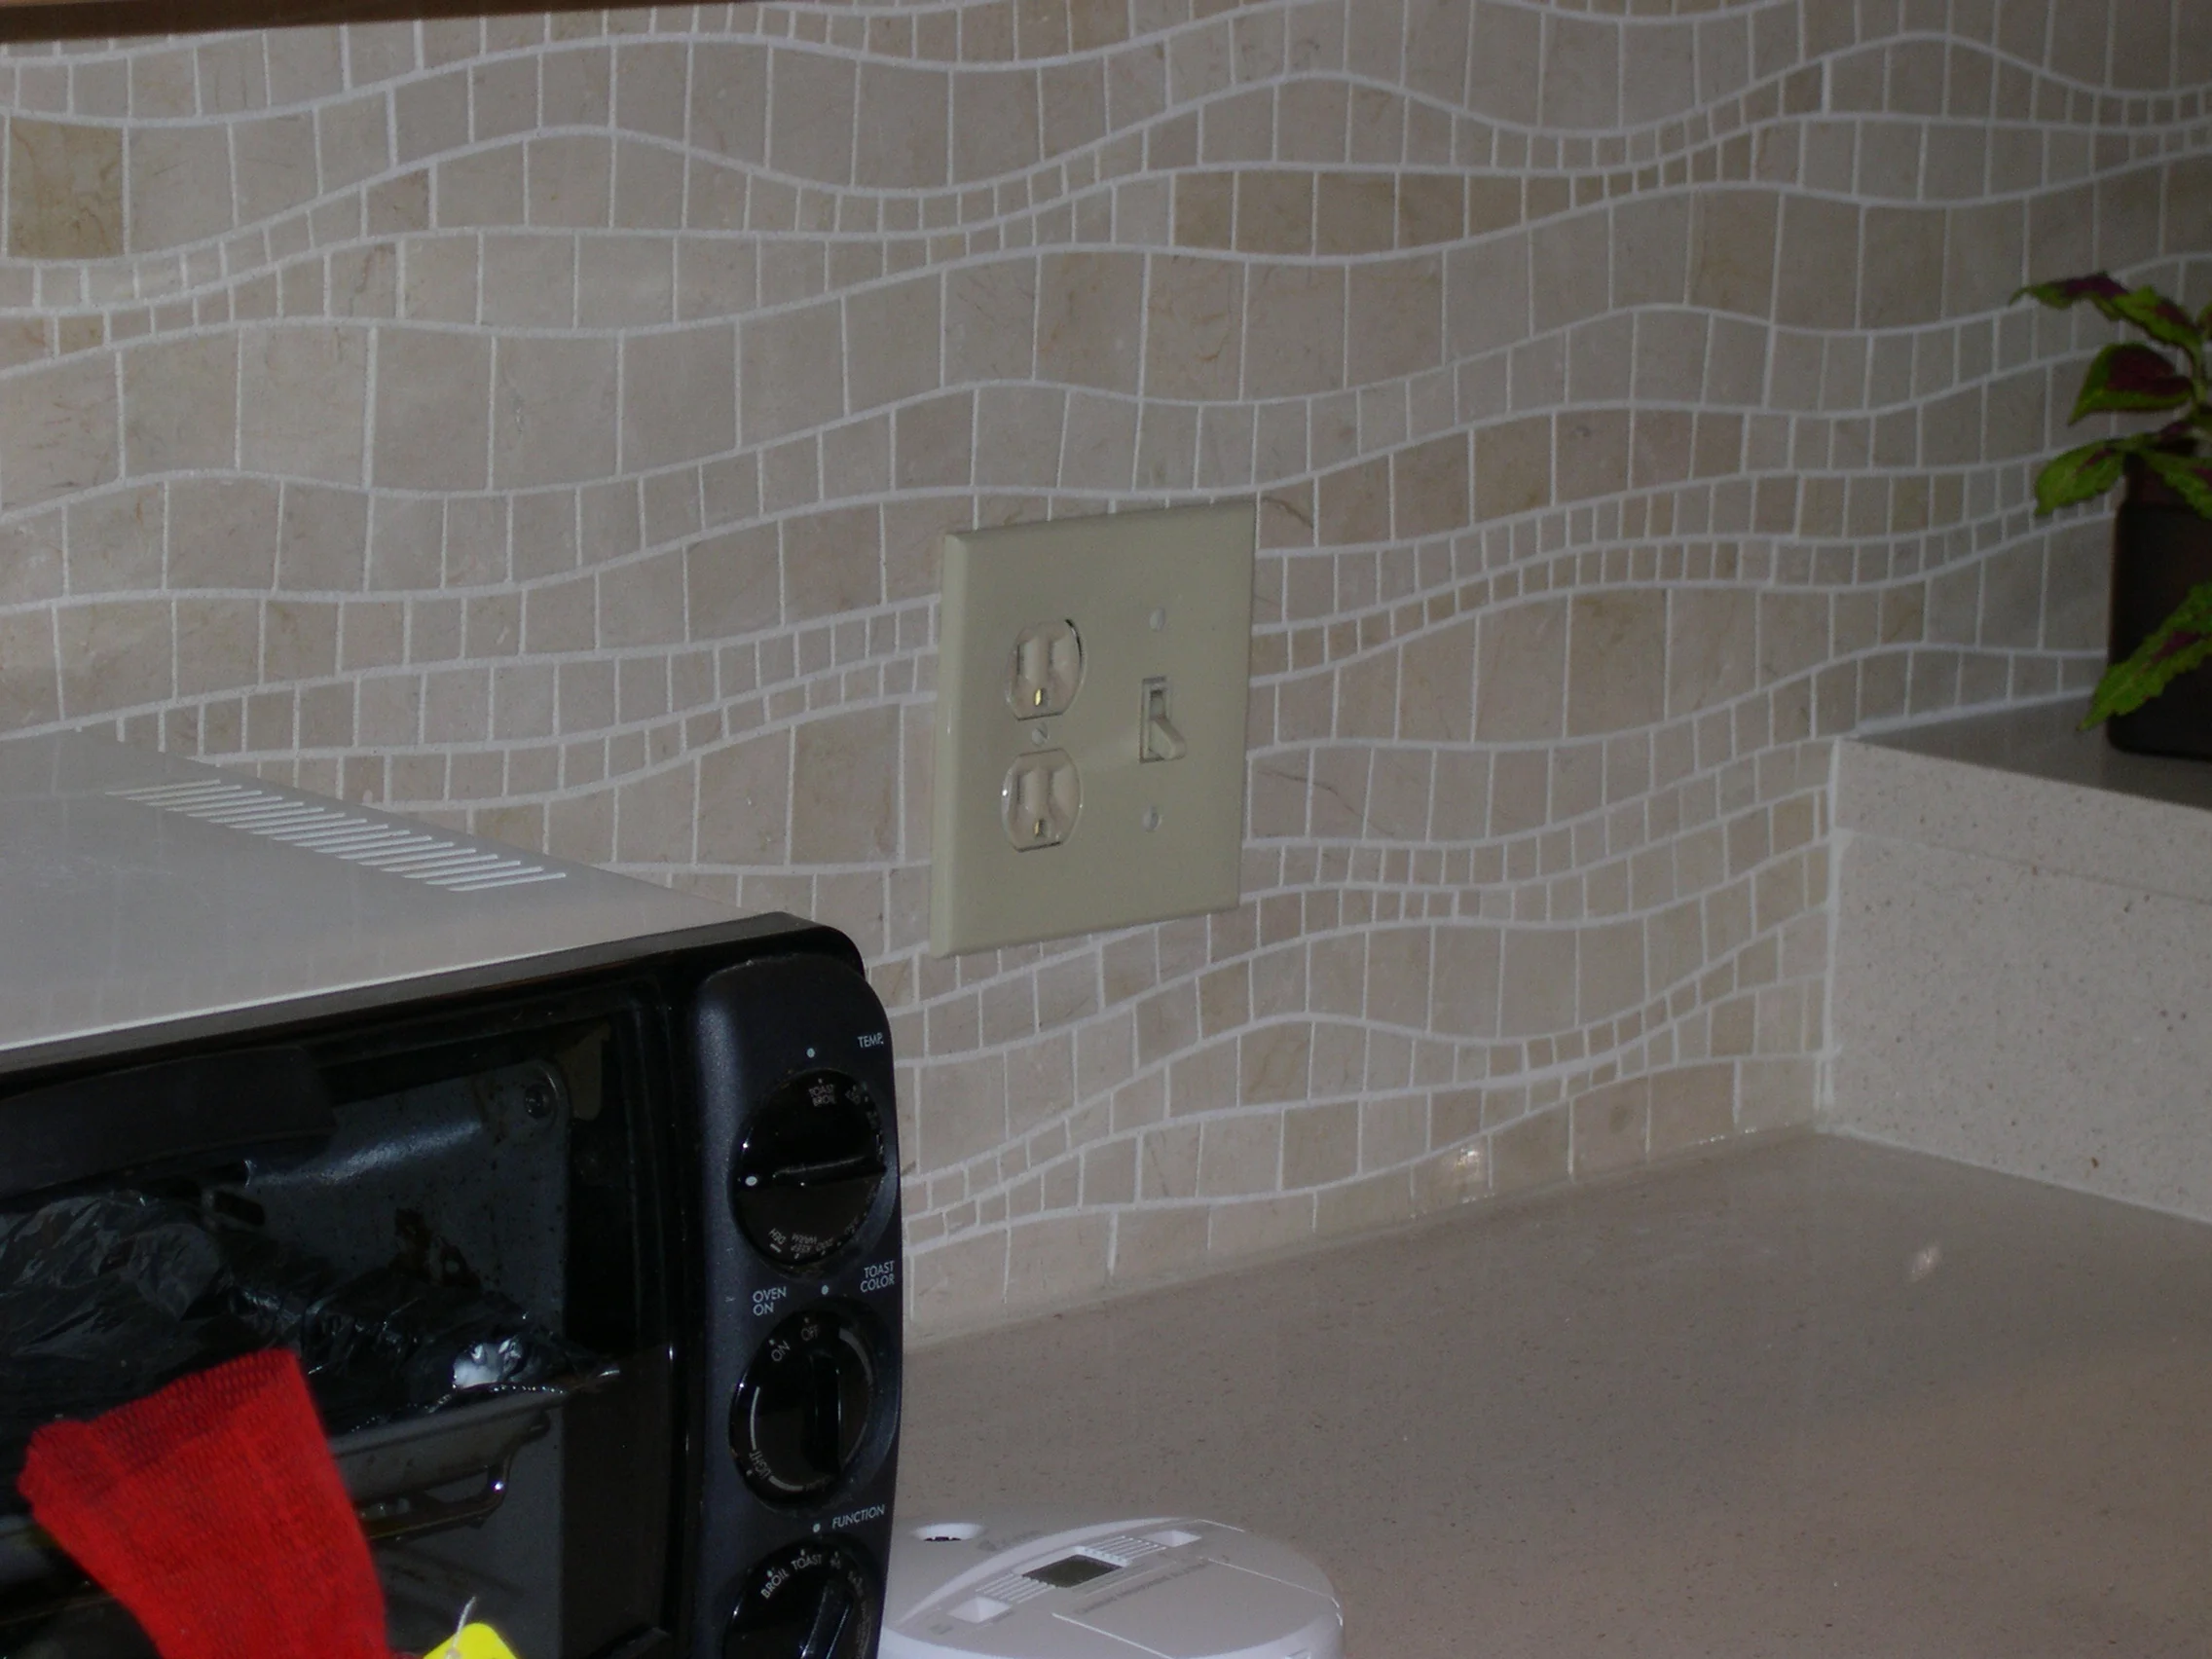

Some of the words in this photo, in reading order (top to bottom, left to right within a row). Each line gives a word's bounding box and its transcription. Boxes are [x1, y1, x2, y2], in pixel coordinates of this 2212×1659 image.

[858, 1033, 884, 1049] TEMP.
[864, 1260, 895, 1278] TOAST
[860, 1273, 895, 1293] COLOR
[753, 1286, 787, 1304] OVEN
[753, 1303, 775, 1316] ON
[800, 1325, 819, 1342] OFF
[771, 1340, 791, 1362] ON
[831, 1504, 885, 1530] FUNCTION
[760, 1569, 791, 1600] BROIL
[791, 1555, 823, 1572] TOAST
